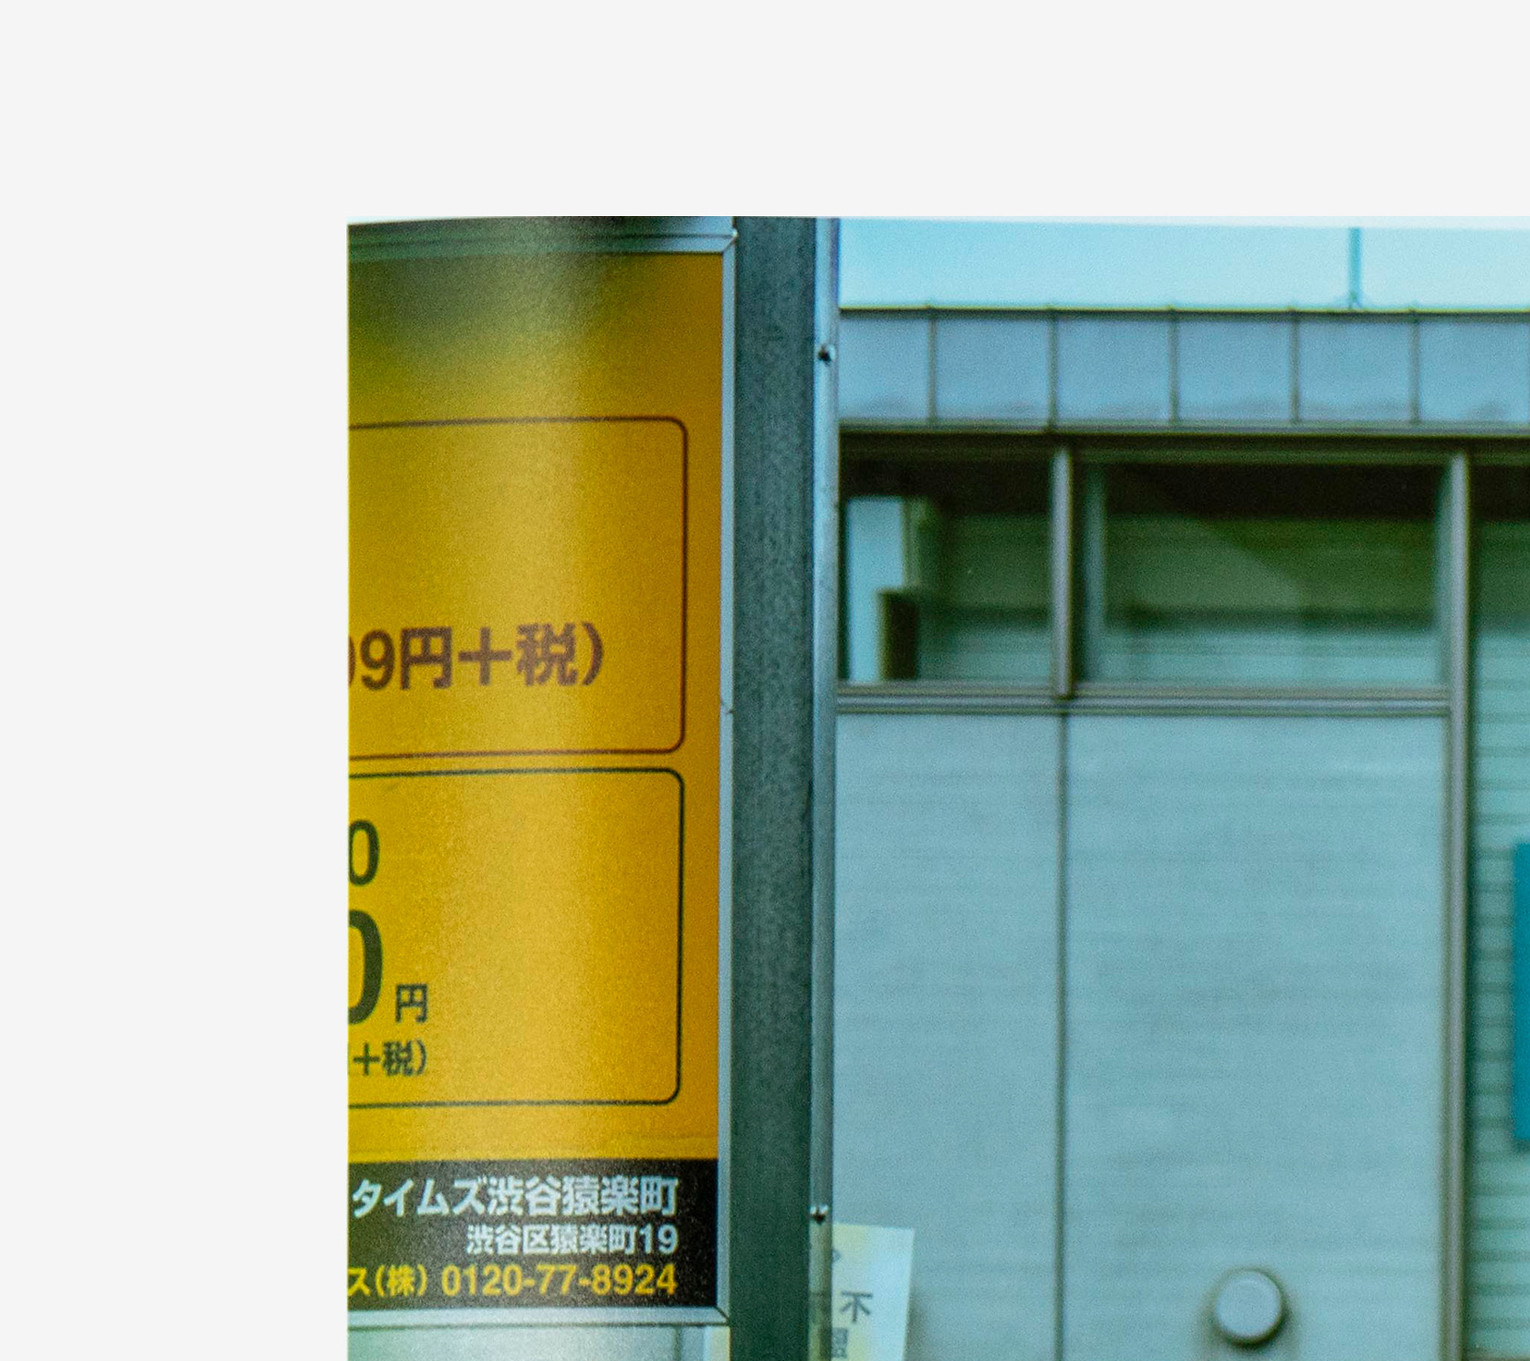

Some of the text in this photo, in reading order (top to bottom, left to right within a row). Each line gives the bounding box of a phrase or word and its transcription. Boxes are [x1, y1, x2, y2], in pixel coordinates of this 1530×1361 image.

[352, 1174, 680, 1219] タイムズ渋谷猿楽町
[466, 1223, 680, 1255] 渋谷区猿楽町19
[441, 1263, 679, 1297] 0120-77-8924
